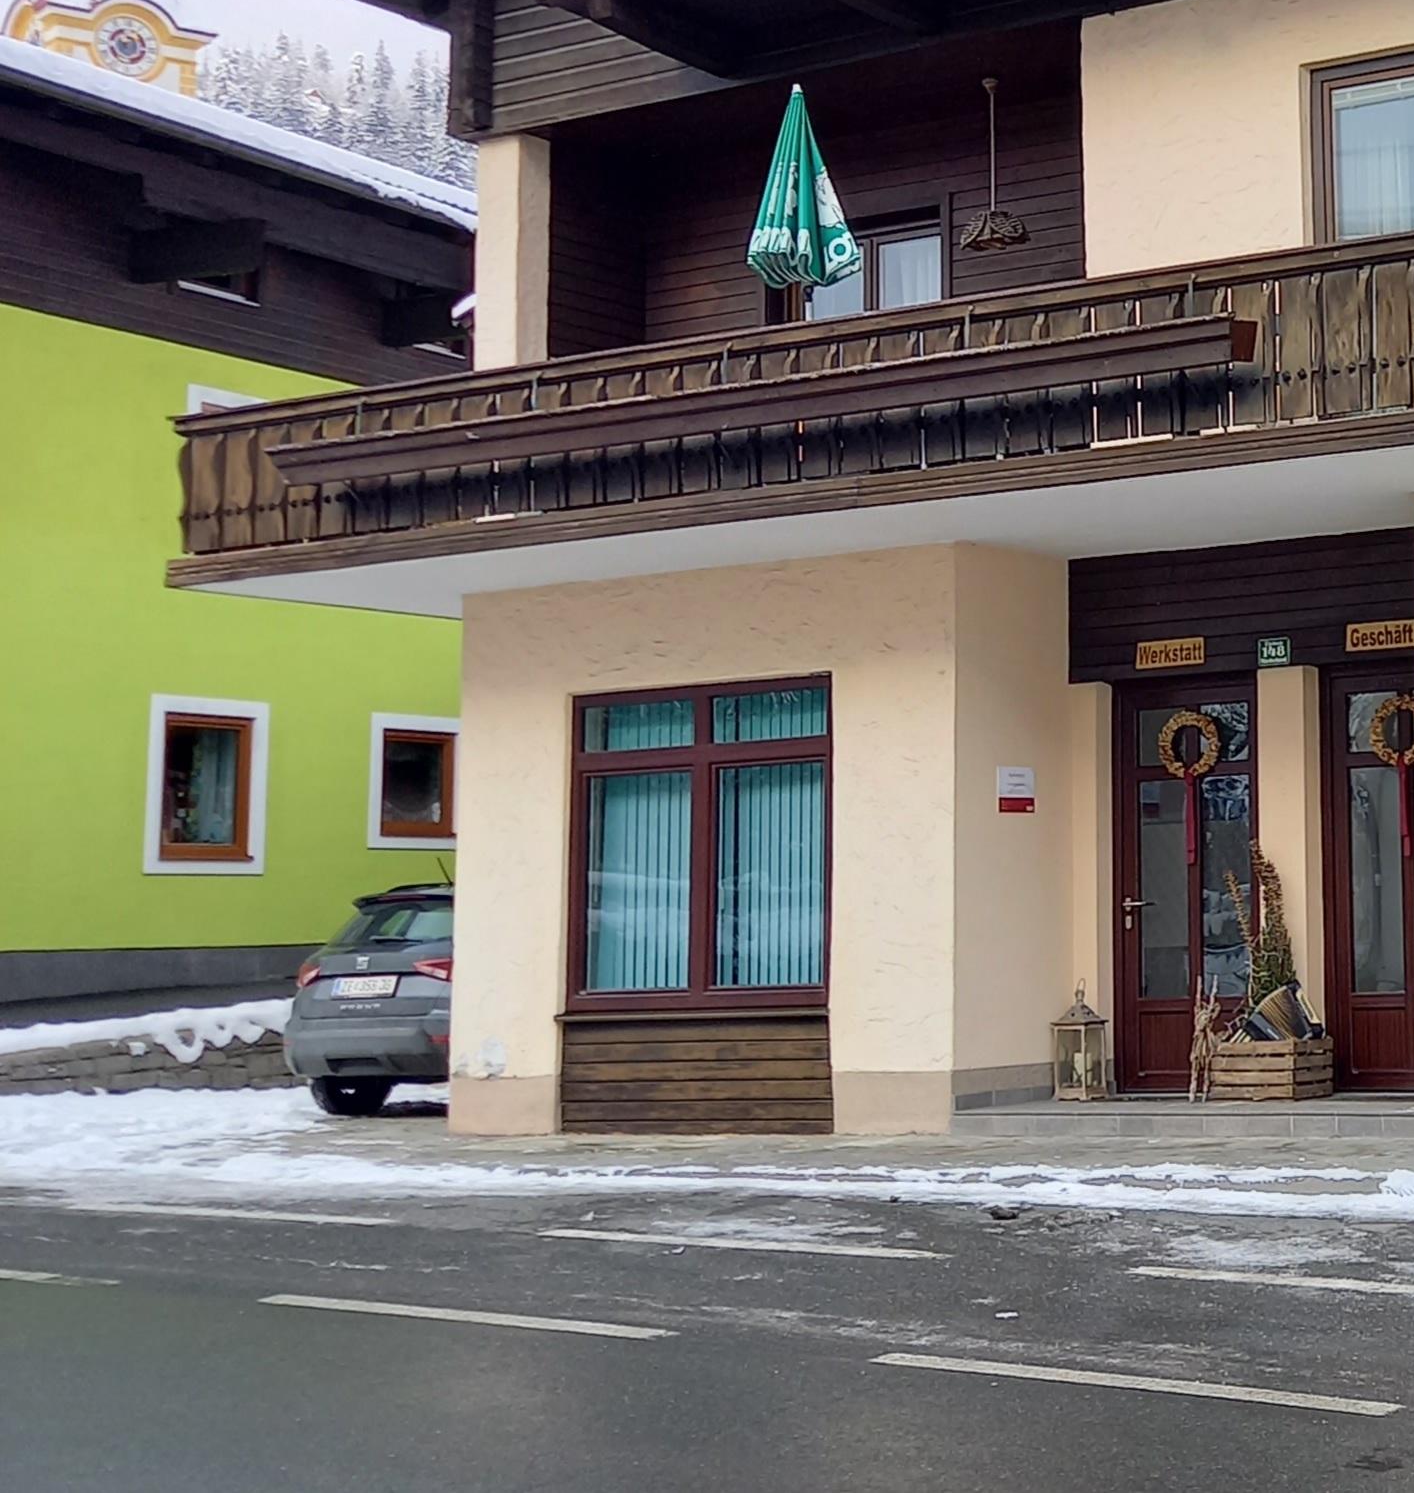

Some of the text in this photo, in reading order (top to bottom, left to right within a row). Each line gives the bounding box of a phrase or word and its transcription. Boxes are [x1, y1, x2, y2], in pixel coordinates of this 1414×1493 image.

[1350, 623, 1414, 648] Geschäft
[1138, 642, 1203, 666] Werkstatt
[1262, 645, 1285, 658] 148
